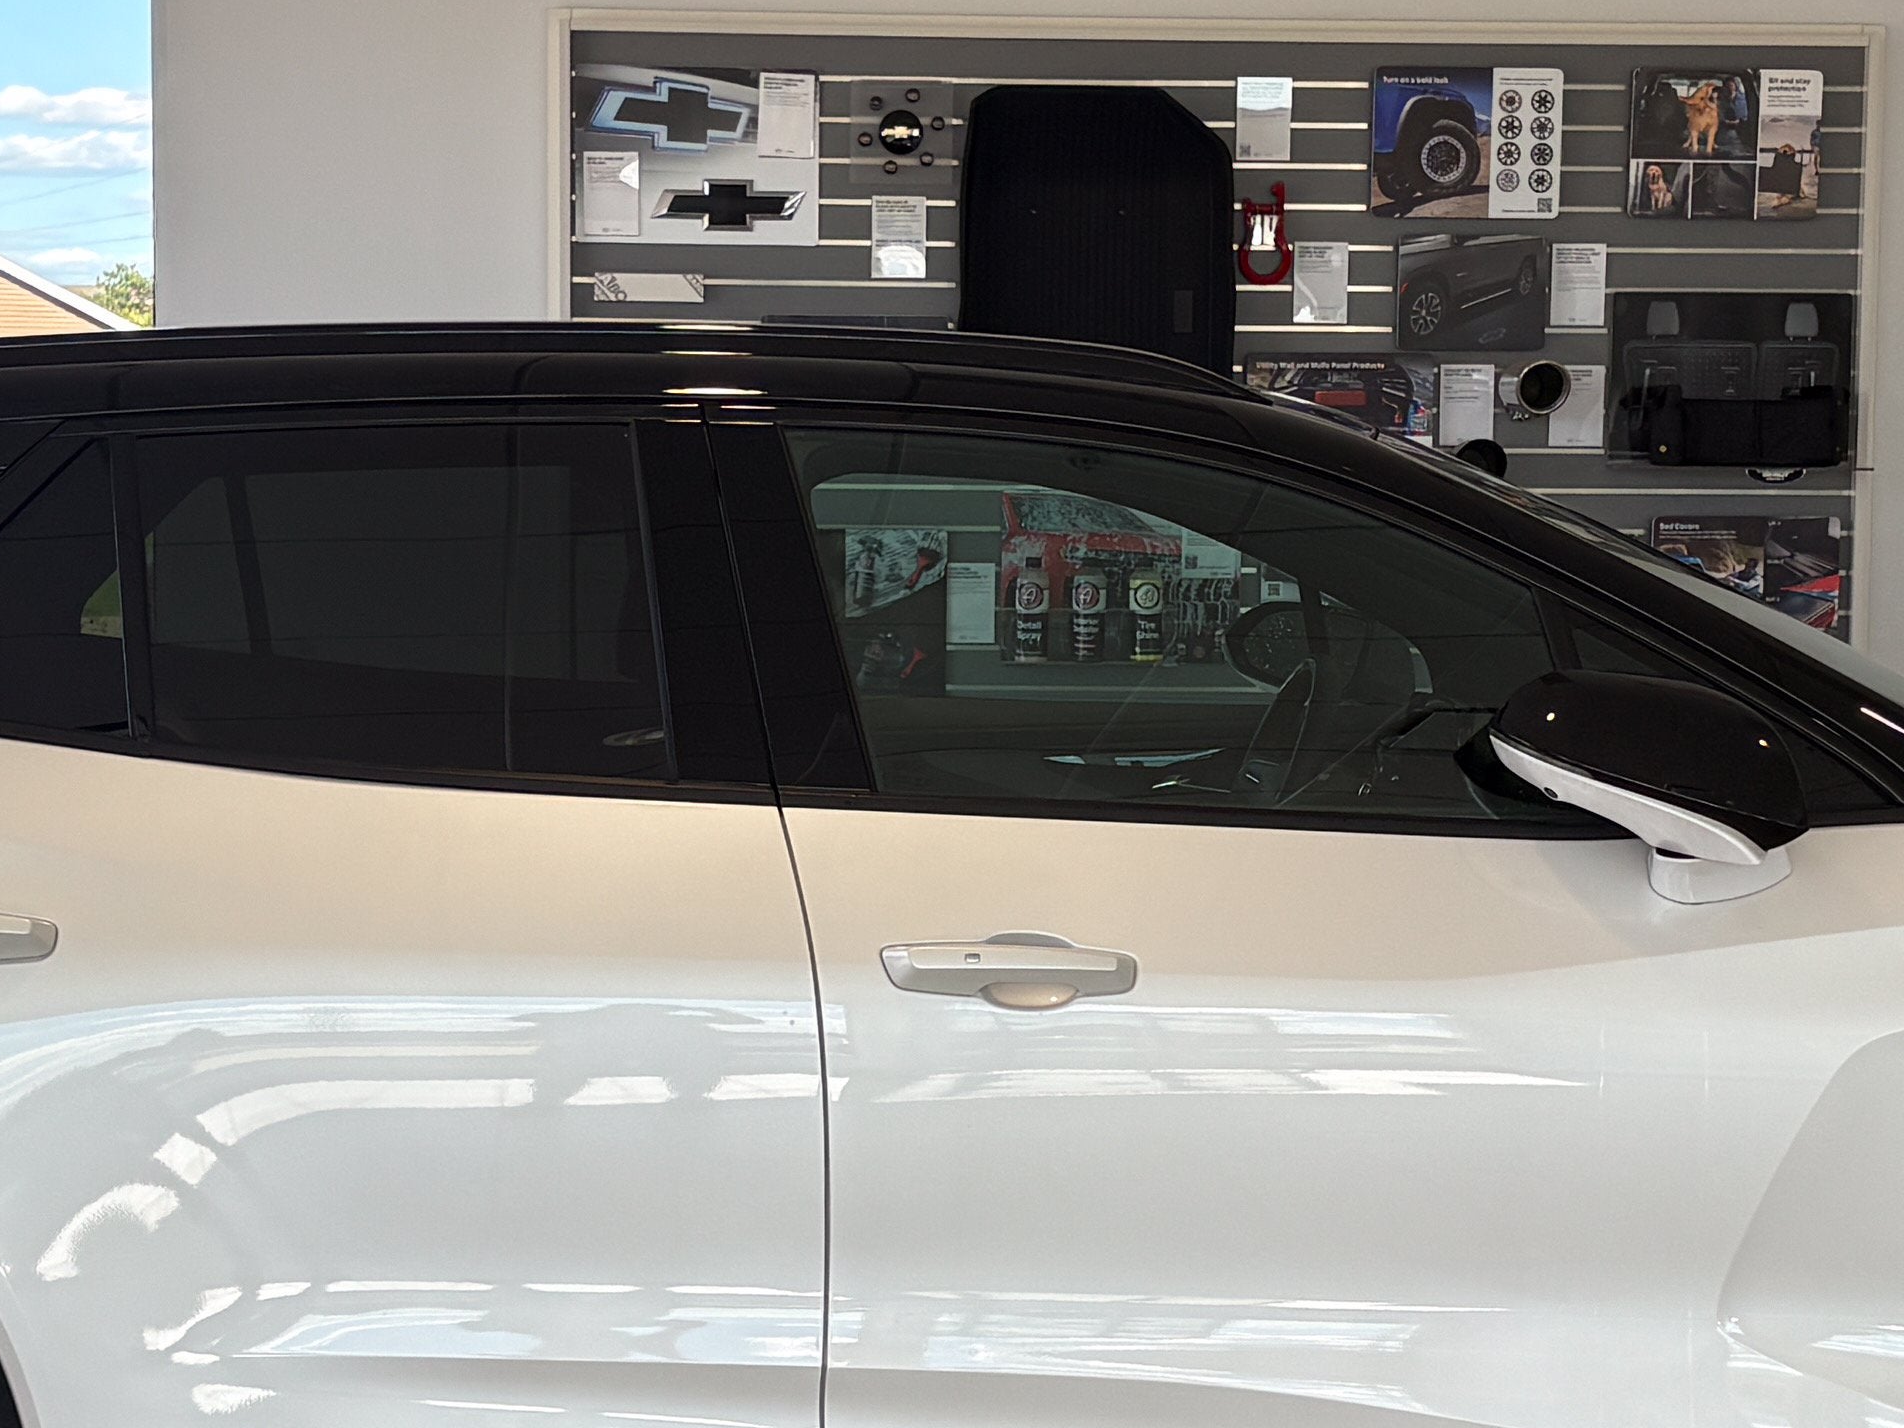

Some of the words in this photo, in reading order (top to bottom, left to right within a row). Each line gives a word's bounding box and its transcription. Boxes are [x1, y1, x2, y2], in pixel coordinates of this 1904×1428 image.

[1795, 78, 1811, 86] stay
[1675, 522, 1700, 530] Covers
[1017, 620, 1042, 629] Detail
[1137, 620, 1156, 629] Tire
